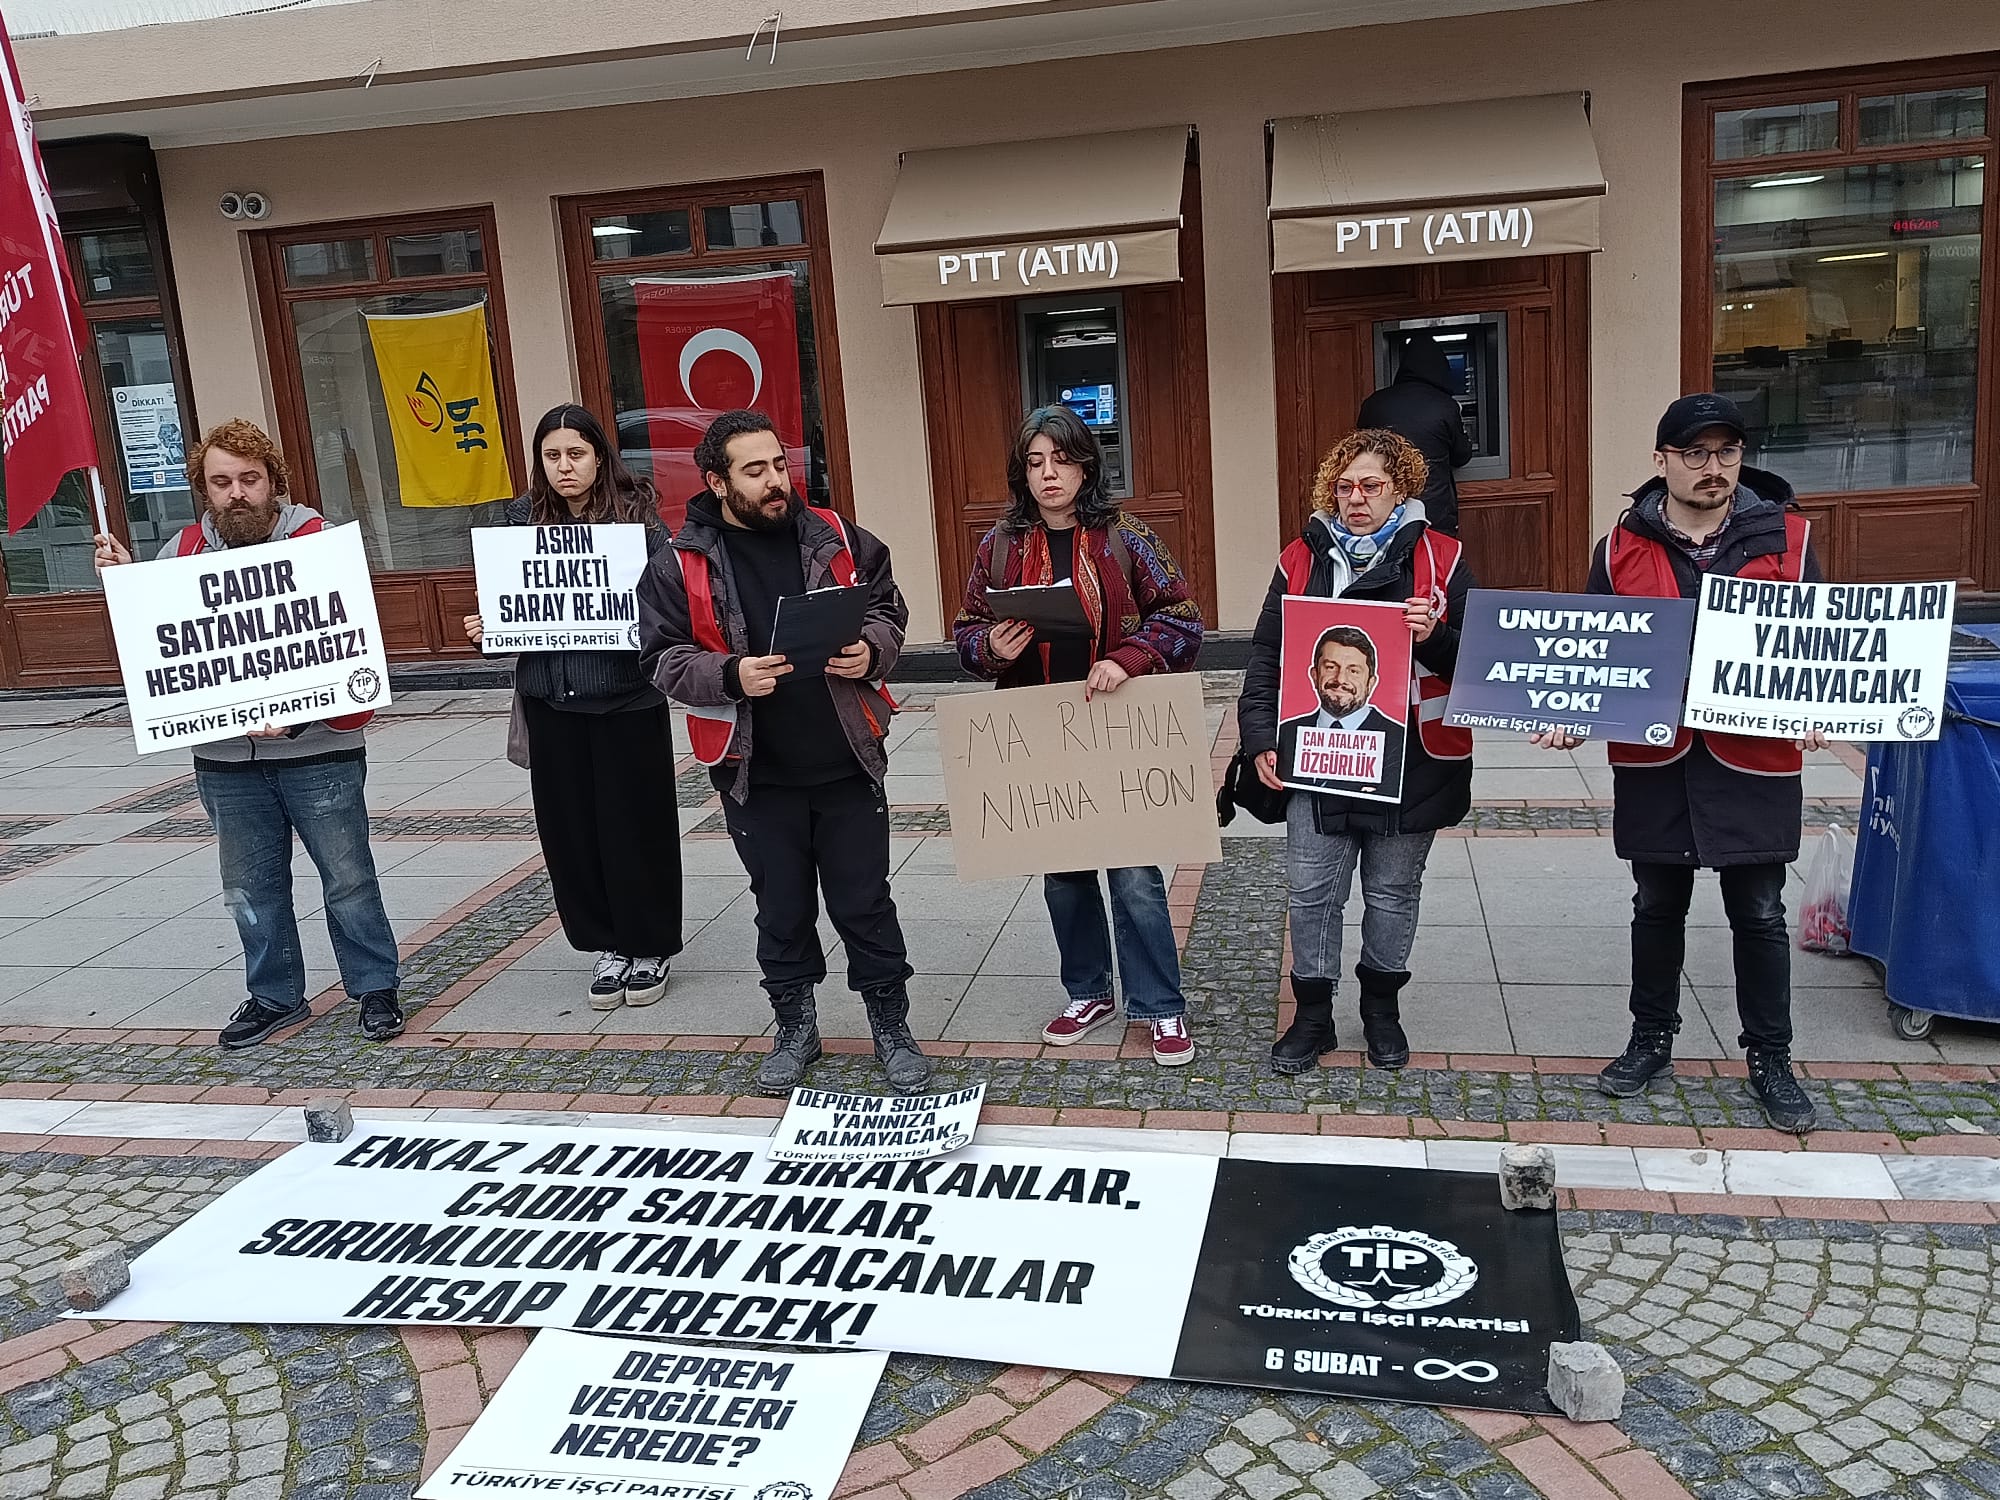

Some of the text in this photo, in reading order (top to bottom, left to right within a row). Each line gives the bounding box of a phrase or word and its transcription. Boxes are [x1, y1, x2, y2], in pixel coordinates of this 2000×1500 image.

[1336, 207, 1534, 255] PTT (ATM)
[938, 240, 1120, 286] PTT (ATM)
[131, 397, 164, 407] DİKKAT!
[535, 526, 594, 555] ASRIN
[199, 559, 297, 613] ÇADIR
[522, 555, 610, 588] FELAKETİ
[500, 589, 635, 623] SARAY REJİMİ
[1707, 577, 1948, 623] DEPREM SUÇLARI
[156, 590, 348, 658] SATANLARLA
[1498, 609, 1653, 634] UNUTMAK
[485, 634, 543, 648] TÜRKİYE
[546, 633, 571, 648] İŞÇİ
[574, 632, 620, 645] PARTİSİ
[1534, 637, 1609, 659] YOK!
[1755, 623, 1888, 662] YANINIZA
[145, 628, 368, 697] HESAPLAŞACAĞIZ!
[1485, 661, 1652, 689] AFFETMEK
[1712, 659, 1922, 703] KALMAYACAK!
[148, 688, 336, 740] TÜRKİYE İŞÇİ PARTİSİ
[1526, 689, 1602, 712] YOK!
[967, 701, 1188, 768] MA RIHNA
[1452, 713, 1509, 729] TÜRKİYE
[1510, 715, 1538, 732] İŞÇİ
[1690, 707, 1884, 735] TÜRKİYE İŞÇİ PARTİSİ
[1303, 731, 1377, 751] CAN ATALAY'A
[1300, 748, 1377, 778] ÖZGÜRLÜK
[982, 764, 1195, 839] NIHNA HON
[796, 1089, 884, 1113] DEPREM
[794, 1121, 961, 1147] KALMAYACAK!
[832, 1112, 937, 1130] YANINIZA
[773, 1148, 931, 1162] TÜRKİYE İŞÇİ PARTİSİ
[334, 1135, 1140, 1210] ENKAZ ALTINDA BIRAKANLAR.
[443, 1181, 936, 1246] ÇADIR SATANLAR.
[239, 1218, 1095, 1305] SORUMLULUKTAN KAÇANLAR
[1306, 1230, 1358, 1255] TÜRKİYE
[1409, 1236, 1462, 1262] PARTİSİ
[1340, 1242, 1429, 1270] TİP
[343, 1275, 878, 1345] HESAP VERECEK!
[1239, 1304, 1530, 1334] TÜRKİYE İŞÇİ PARTİSİ
[613, 1350, 795, 1392] DEPREM
[1265, 1348, 1285, 1370] 6
[568, 1385, 798, 1431] VERGİLERİ
[550, 1423, 762, 1468] NEREDE?
[449, 1471, 737, 1500] TÜRKİYE İŞÇİ PARTİSİ
[773, 1488, 800, 1499] TİP
